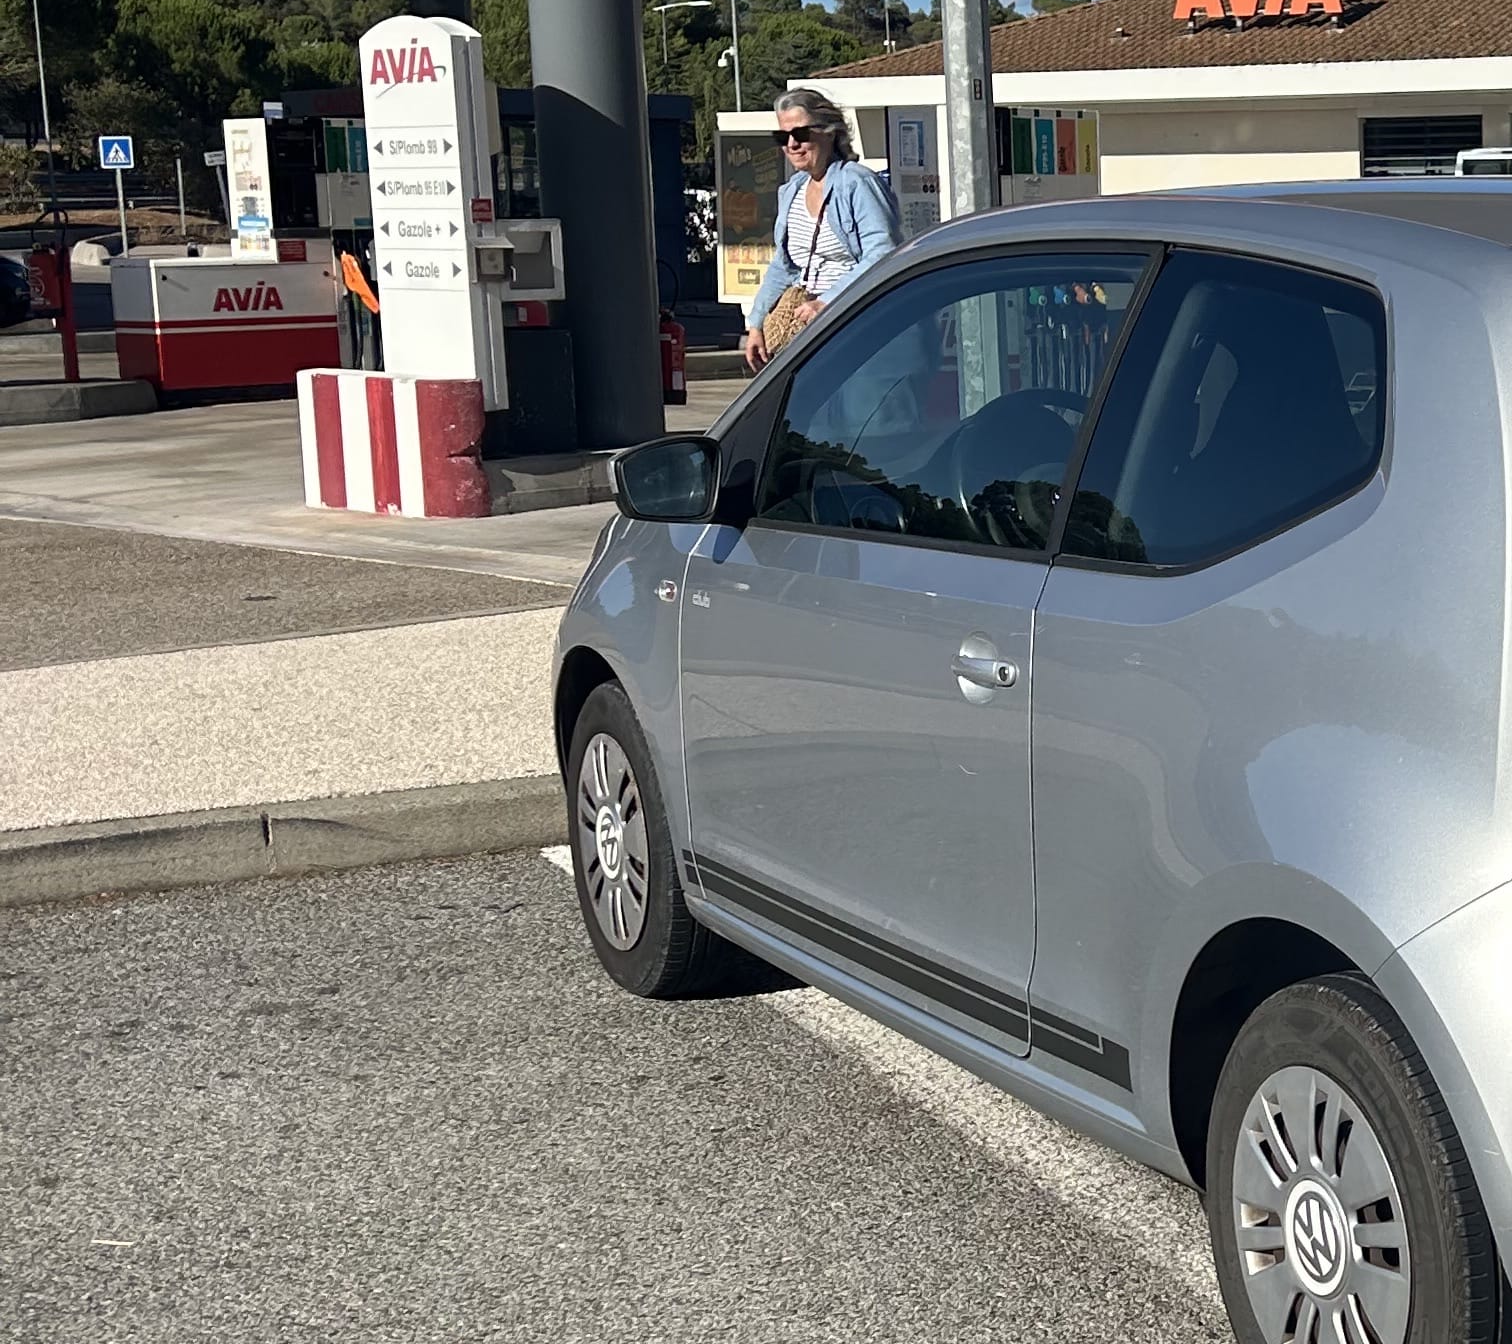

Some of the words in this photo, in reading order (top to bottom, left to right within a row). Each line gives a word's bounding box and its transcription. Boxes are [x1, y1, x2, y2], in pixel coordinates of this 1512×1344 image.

[370, 38, 438, 85] AVIA
[389, 140, 426, 155] S/Plomb
[387, 181, 424, 196] S/Plomb
[398, 221, 433, 238] Gazole
[405, 261, 440, 279] Gazole
[213, 281, 284, 312] AVIA
